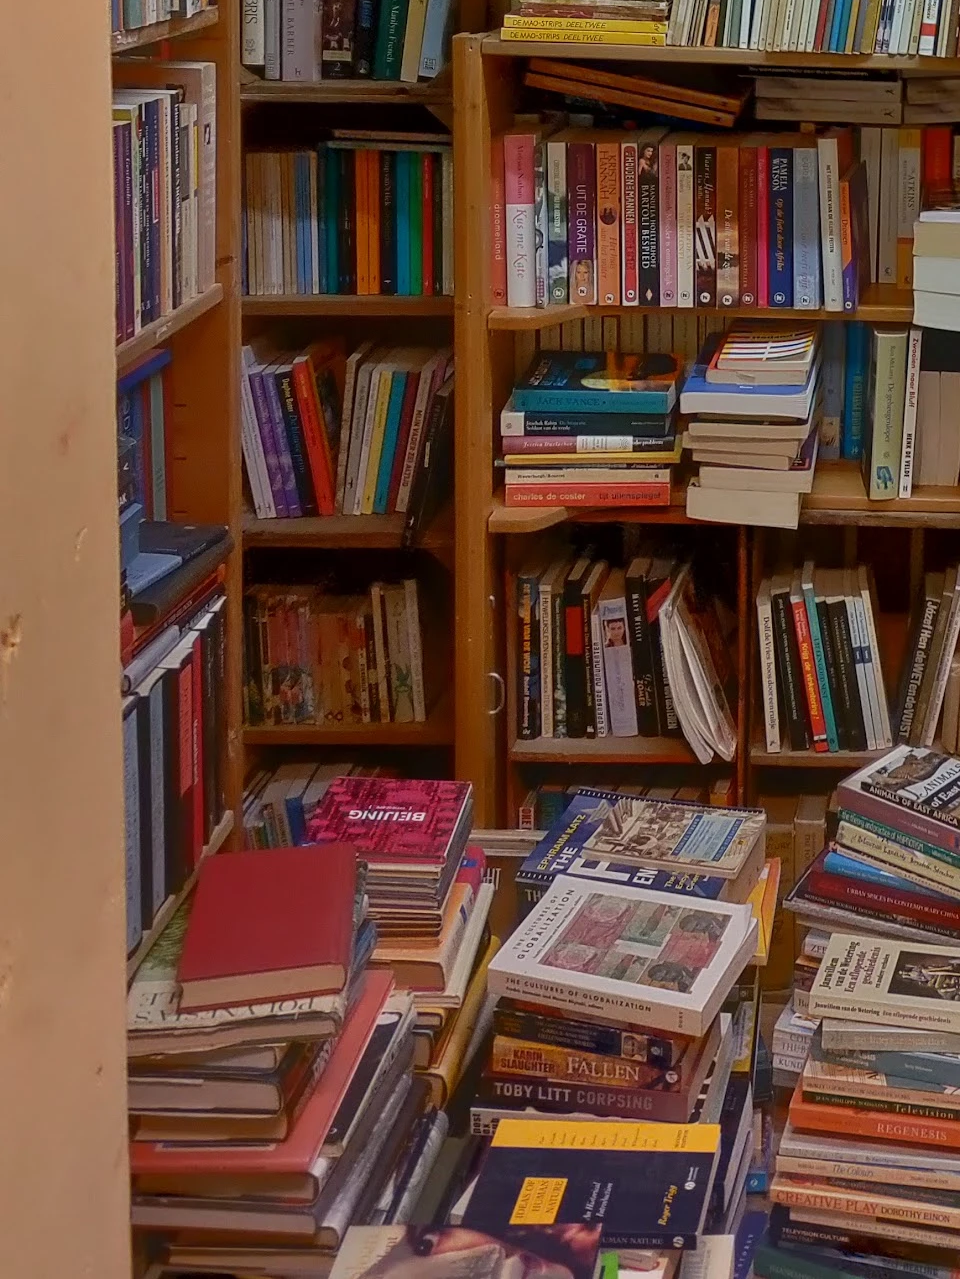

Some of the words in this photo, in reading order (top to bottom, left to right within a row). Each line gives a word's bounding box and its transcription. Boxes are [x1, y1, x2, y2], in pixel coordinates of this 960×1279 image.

[286, 17, 294, 56] BARBER
[772, 158, 780, 191] WATSON
[779, 158, 788, 191] PAMELA
[575, 184, 587, 200] UIT
[641, 185, 649, 227] BARTOLI
[576, 202, 587, 216] DE
[576, 217, 588, 254] GRATIE
[641, 229, 649, 269] BESPIED
[536, 397, 563, 406] JACK
[566, 397, 602, 406] VANCE
[348, 809, 427, 823] BEIJING
[869, 786, 900, 803] ANIMALS
[901, 798, 912, 807] OF
[913, 802, 931, 814] EAST
[932, 809, 959, 826] AFRICA
[536, 833, 570, 871] EPHRAIM
[567, 813, 586, 839] KATZ
[550, 847, 578, 872] THE
[517, 889, 575, 960] GLOBALIZATION
[819, 957, 839, 990] Janwillem
[506, 977, 521, 986] THE
[524, 981, 564, 995] CULTURES
[568, 989, 579, 998] OF
[582, 992, 652, 1013] GLOBALIZATION
[500, 1058, 556, 1073] SLAUGHTER
[567, 1056, 640, 1081] FALLEN
[494, 1082, 533, 1097] TOBY
[537, 1086, 572, 1102] LITT
[576, 1090, 653, 1111] CORPSING
[894, 1103, 955, 1120] Television
[877, 1122, 947, 1141] REGENESIS
[776, 1192, 842, 1209] CREATIVE
[843, 1200, 878, 1215] PLAY
[881, 1206, 923, 1220] DOROTHY
[923, 1211, 950, 1223] EINON
[782, 1227, 819, 1239] TELEVISION
[819, 1233, 850, 1243] CULTURE
